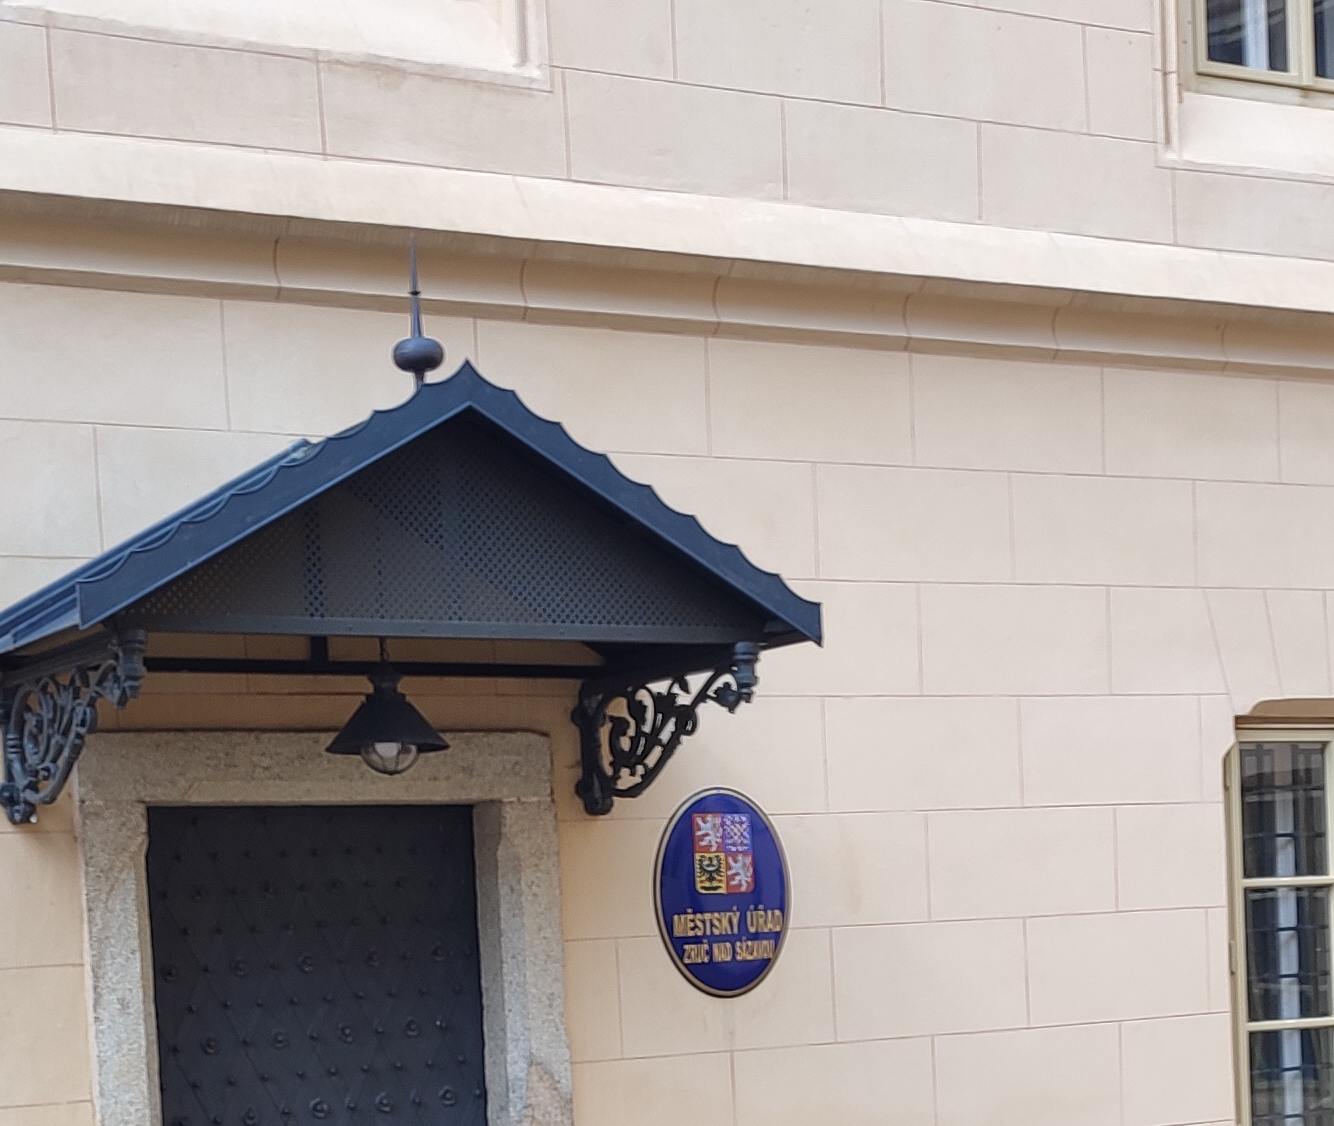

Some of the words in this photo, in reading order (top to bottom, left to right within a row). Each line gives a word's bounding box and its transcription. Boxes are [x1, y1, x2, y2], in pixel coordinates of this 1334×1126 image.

[672, 905, 741, 937] MĚSTSKÝ
[746, 904, 783, 933] ÚŘAD
[712, 941, 733, 962] NAD
